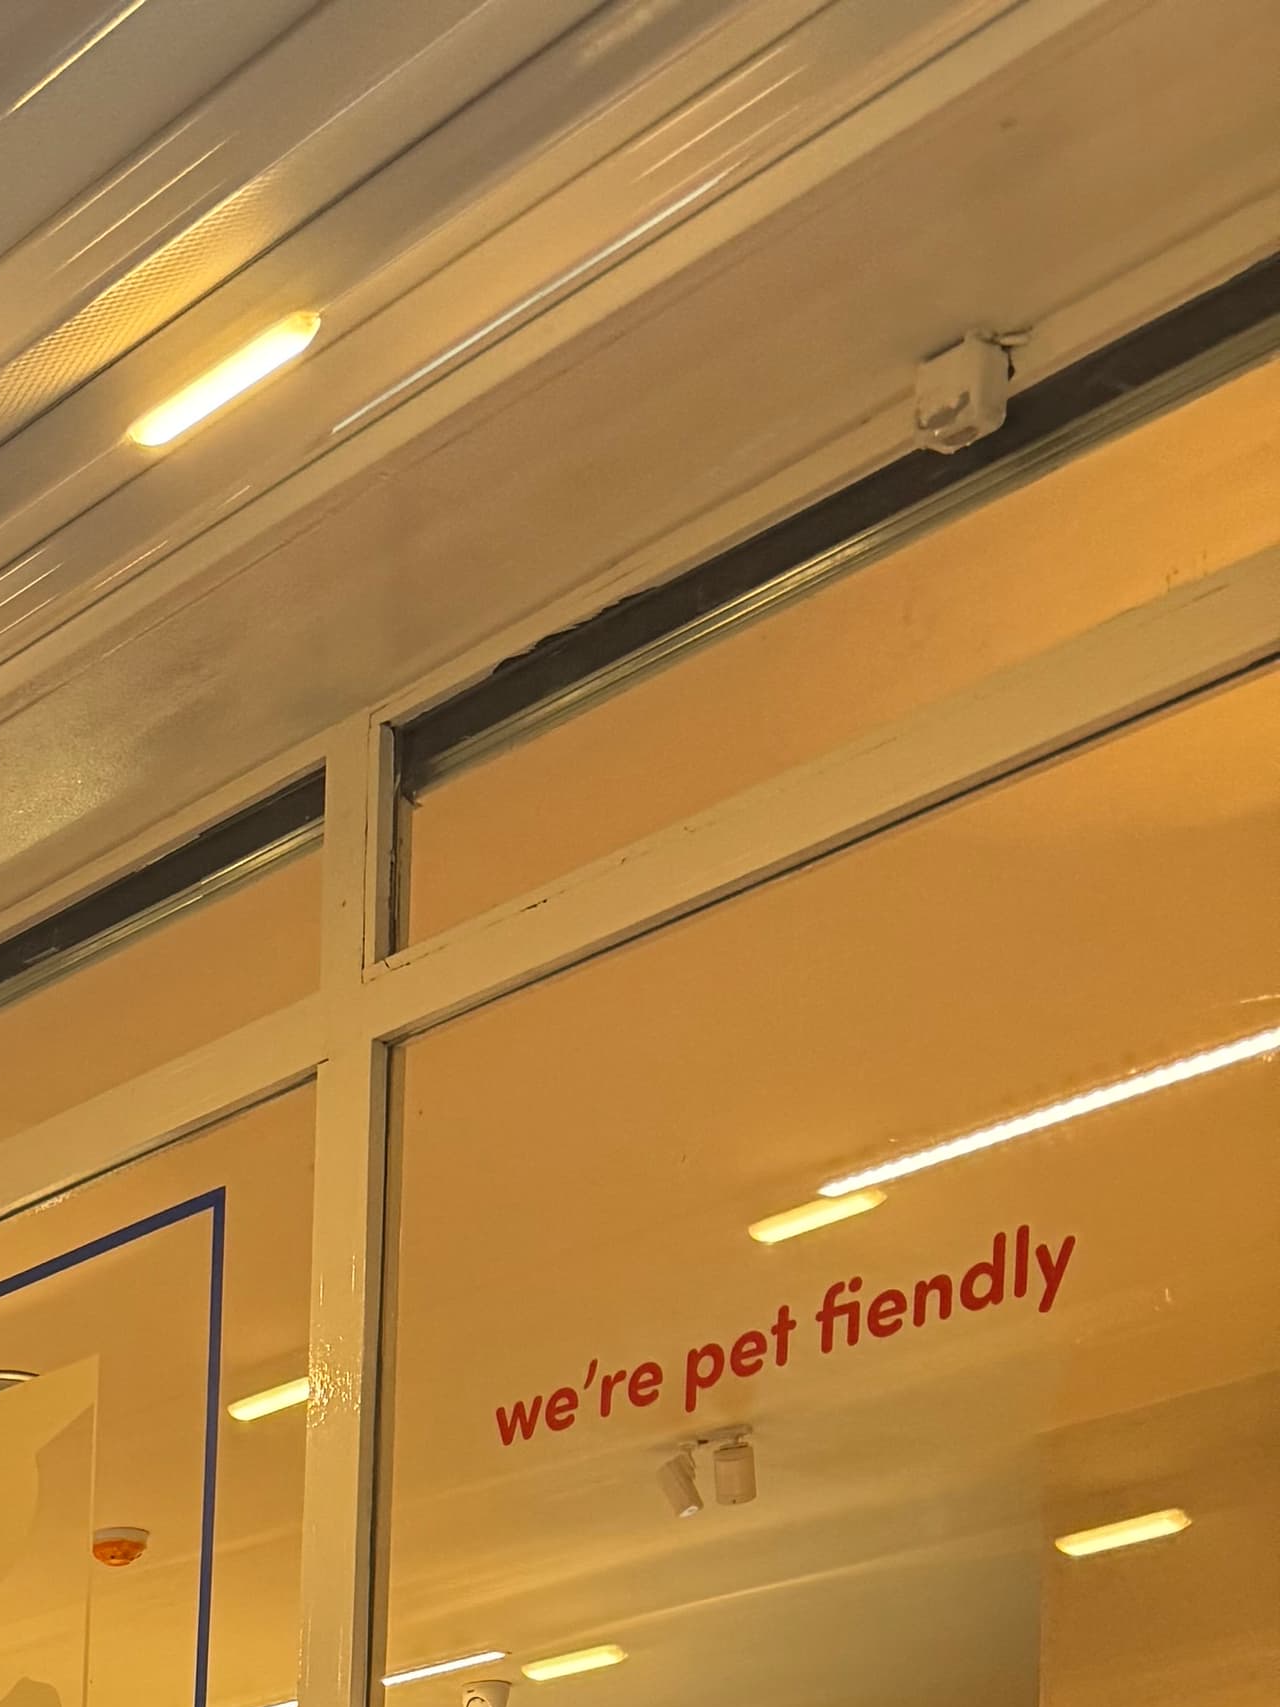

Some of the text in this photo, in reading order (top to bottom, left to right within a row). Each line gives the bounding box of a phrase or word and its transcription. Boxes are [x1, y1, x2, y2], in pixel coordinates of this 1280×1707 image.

[494, 1223, 1078, 1447] we're pet fiendly
